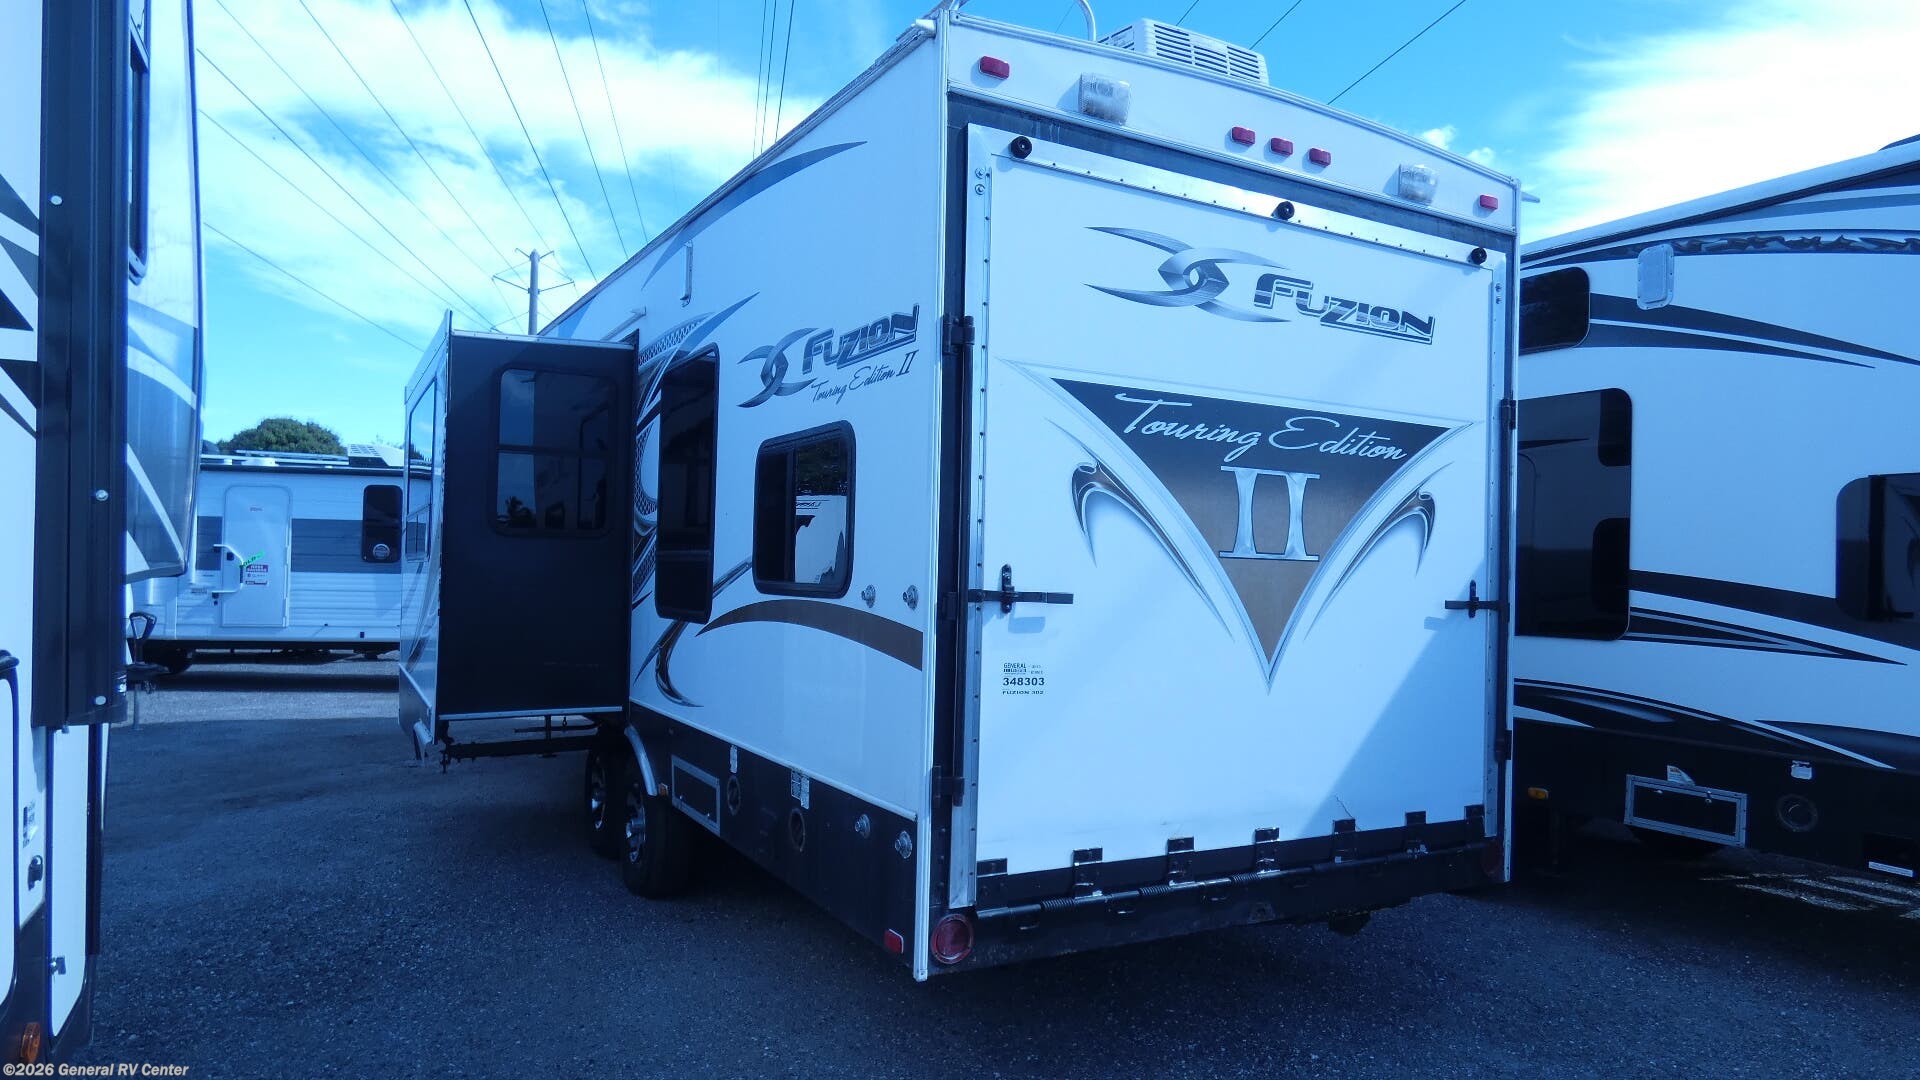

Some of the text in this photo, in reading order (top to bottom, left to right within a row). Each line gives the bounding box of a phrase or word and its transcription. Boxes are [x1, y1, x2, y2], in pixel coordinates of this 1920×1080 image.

[811, 349, 919, 405] Touring Edition II
[1114, 393, 1407, 462] Touring Edition
[1219, 465, 1321, 562] II
[1002, 677, 1045, 686] 348303
